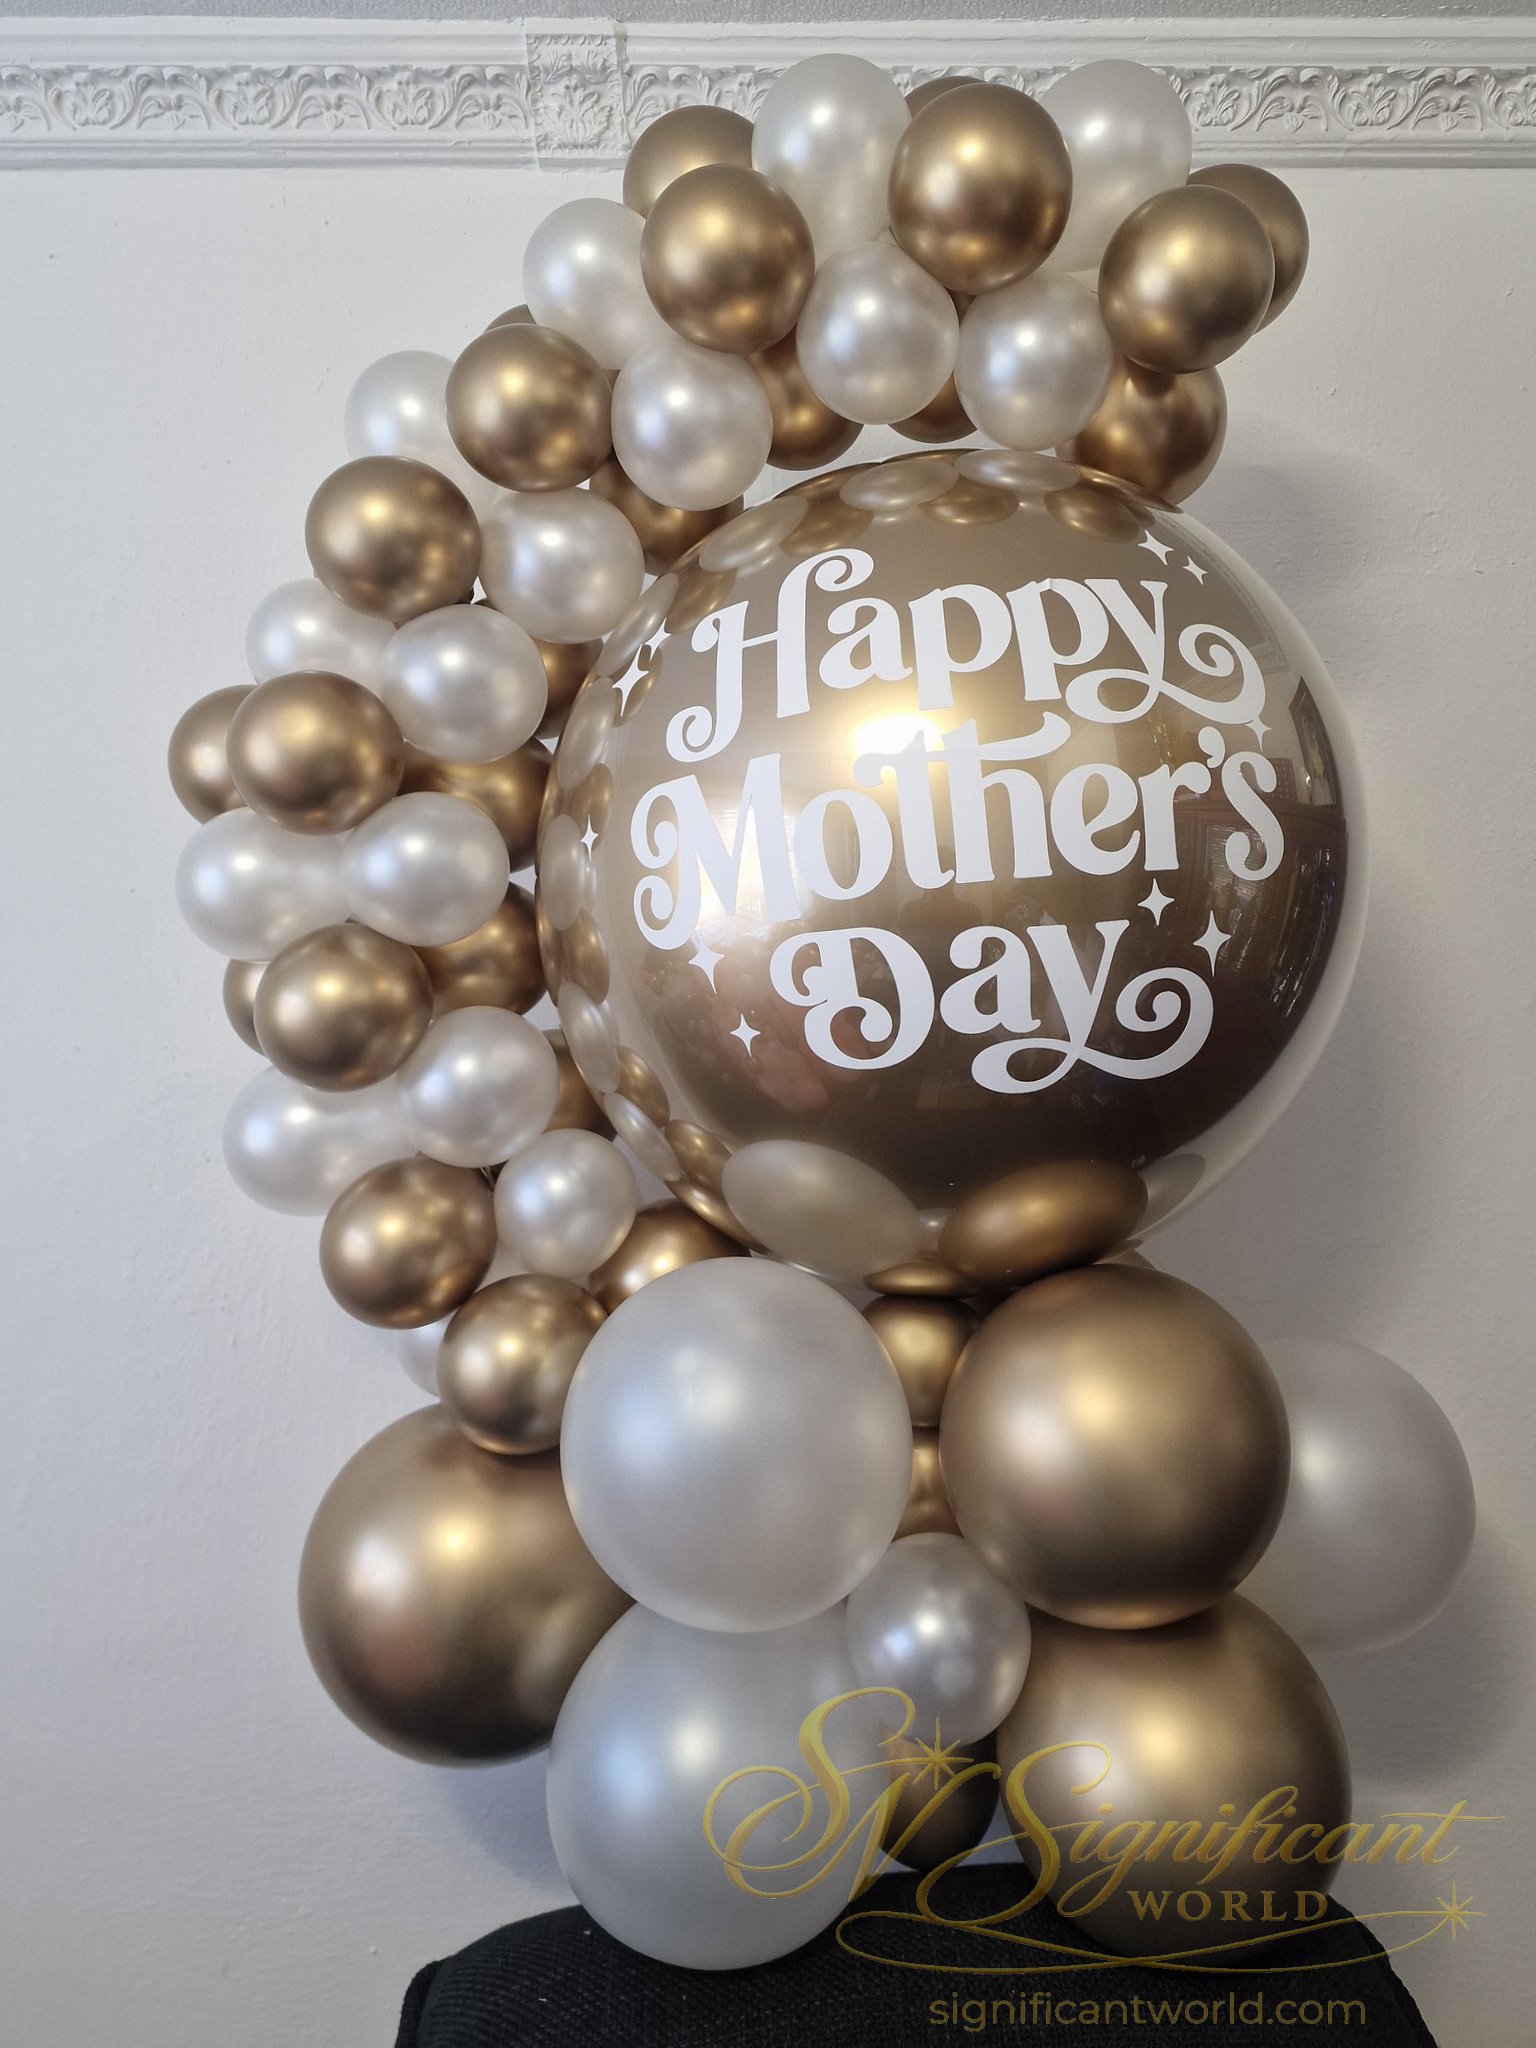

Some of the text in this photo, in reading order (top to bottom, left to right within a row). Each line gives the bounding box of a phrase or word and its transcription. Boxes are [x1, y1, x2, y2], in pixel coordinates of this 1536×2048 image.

[666, 548, 1265, 762] Happy
[631, 712, 1284, 950] Mother's
[770, 919, 1214, 1094] Day
